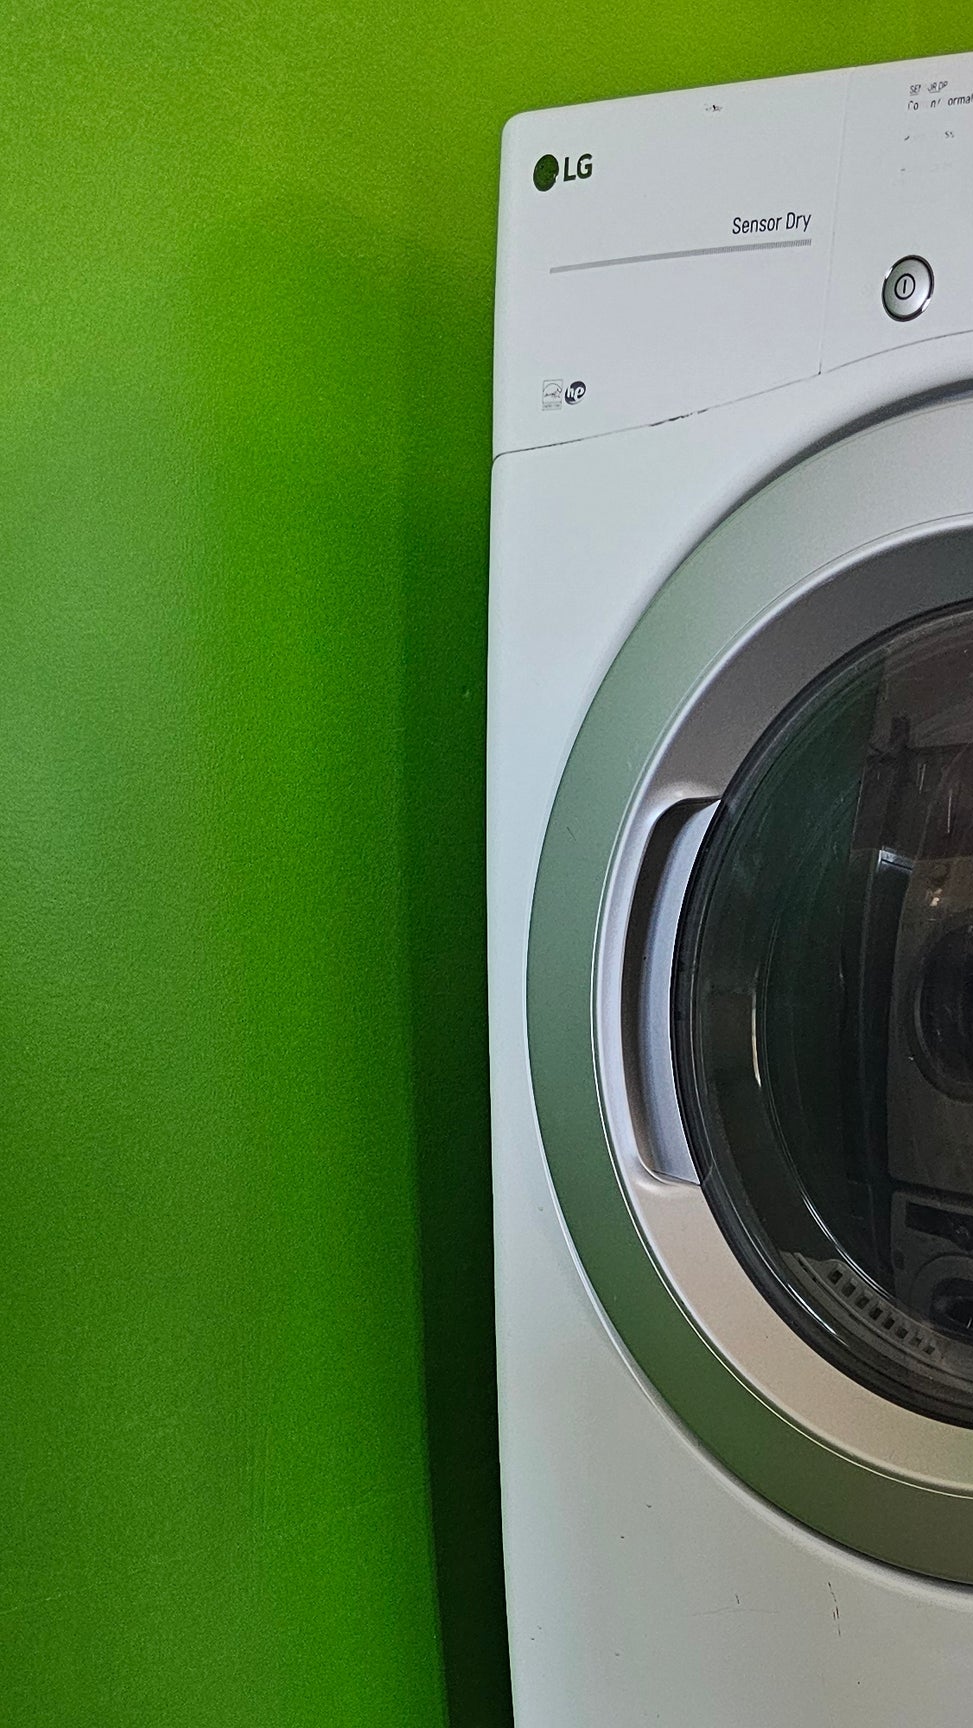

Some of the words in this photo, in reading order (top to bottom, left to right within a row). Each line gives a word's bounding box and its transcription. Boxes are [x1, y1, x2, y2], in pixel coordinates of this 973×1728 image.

[563, 153, 593, 182] LG
[732, 216, 782, 235] Sensor
[785, 212, 812, 232] Dry
